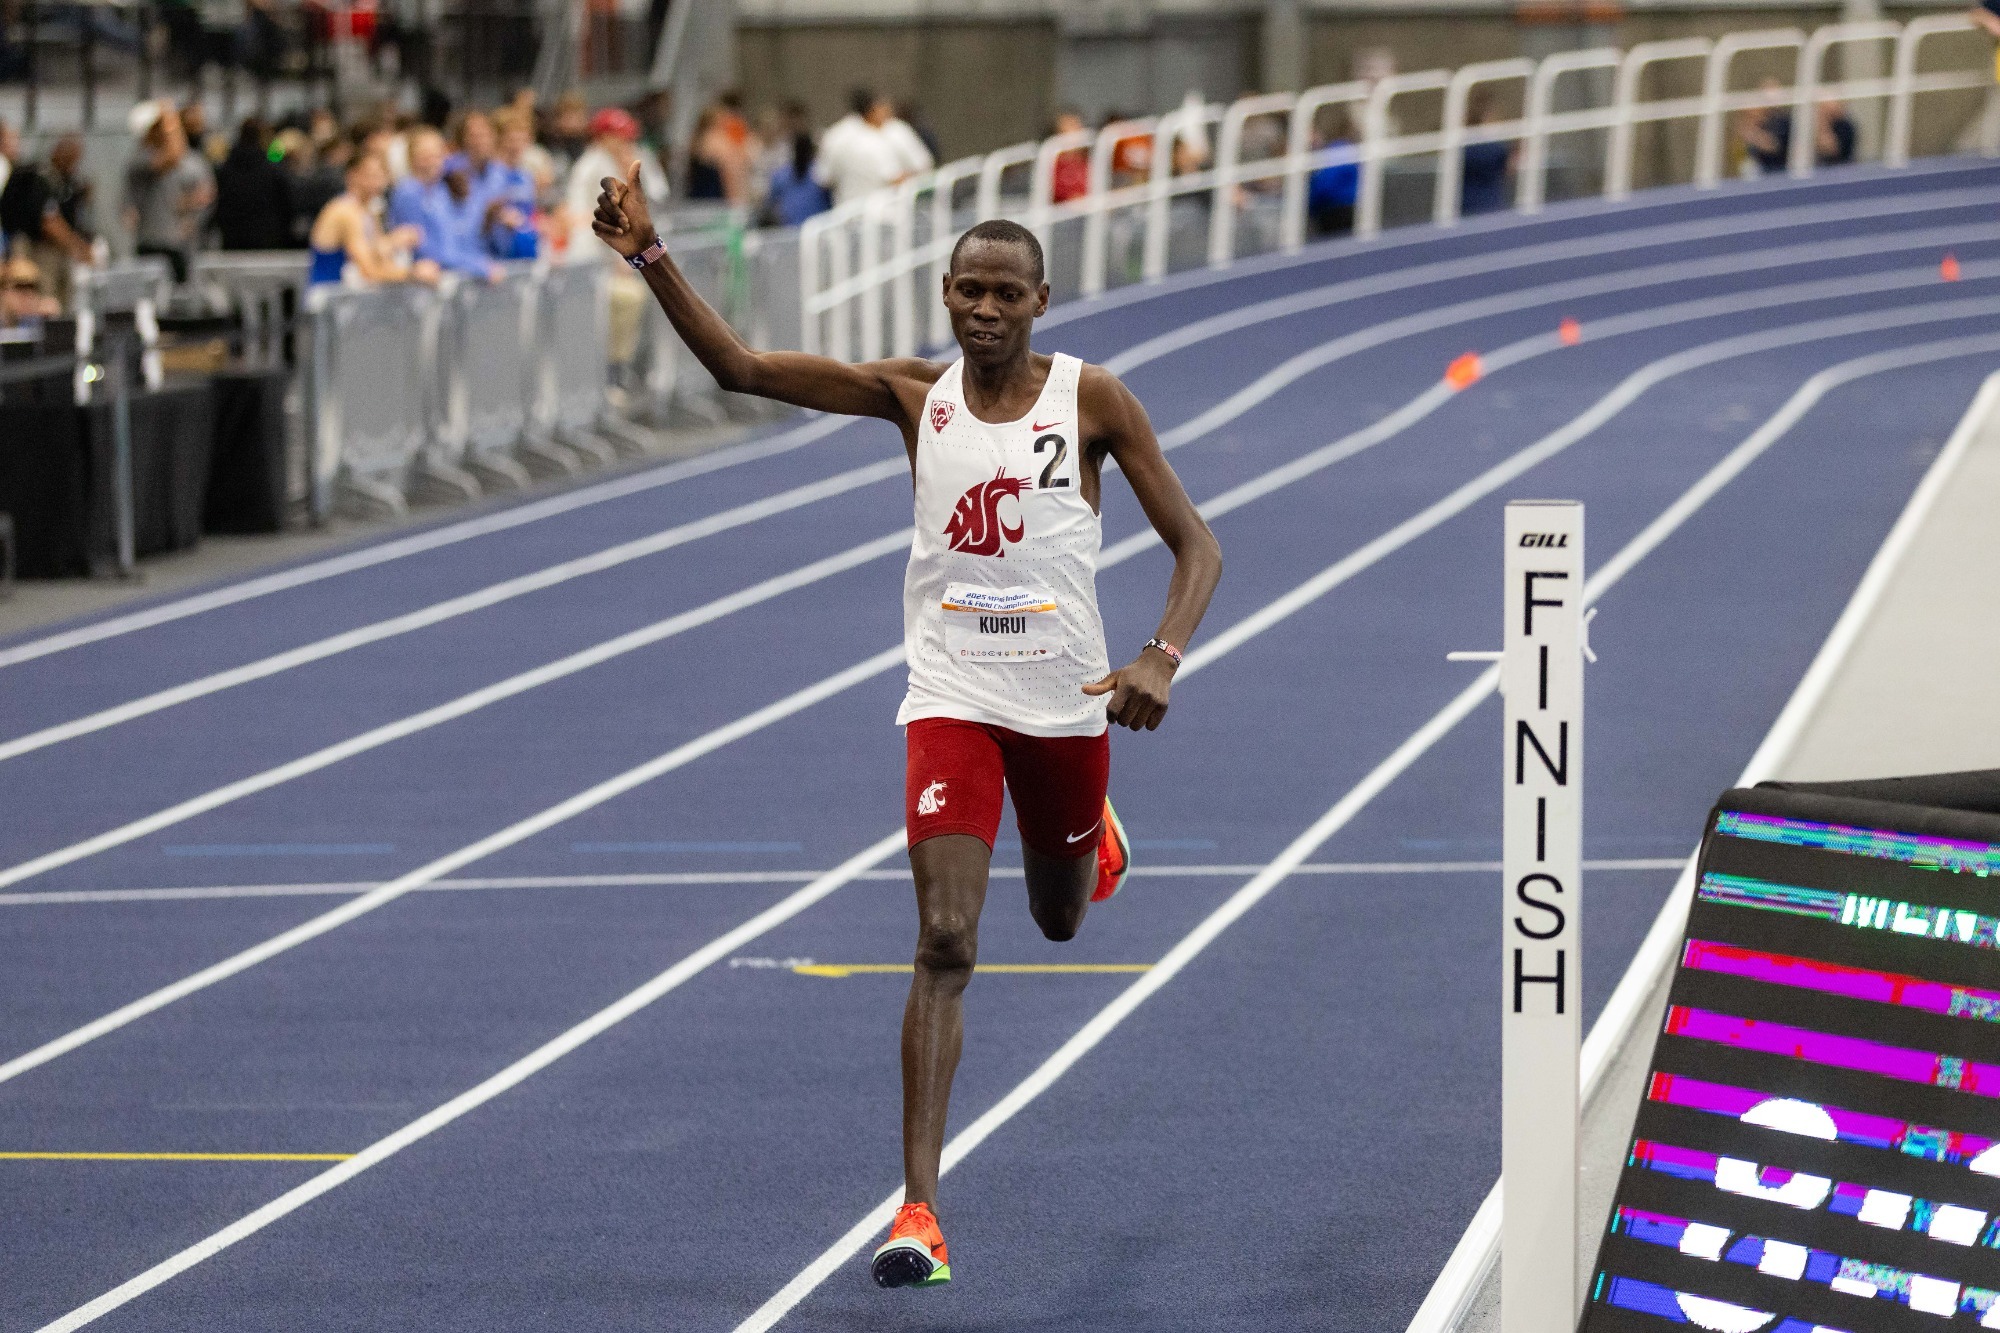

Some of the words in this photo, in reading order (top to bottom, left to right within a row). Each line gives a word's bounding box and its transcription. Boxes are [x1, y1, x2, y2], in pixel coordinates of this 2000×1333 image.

[934, 413, 945, 427] 12
[1033, 433, 1070, 489] 2
[1519, 533, 1567, 548] GILL
[949, 597, 967, 605] Track
[975, 601, 992, 609] Field
[993, 599, 1048, 610] Championships
[966, 592, 987, 600] 2025
[1005, 593, 1030, 602] Indoor
[979, 616, 1026, 634] KURUI
[1513, 570, 1569, 1015] FINISH
